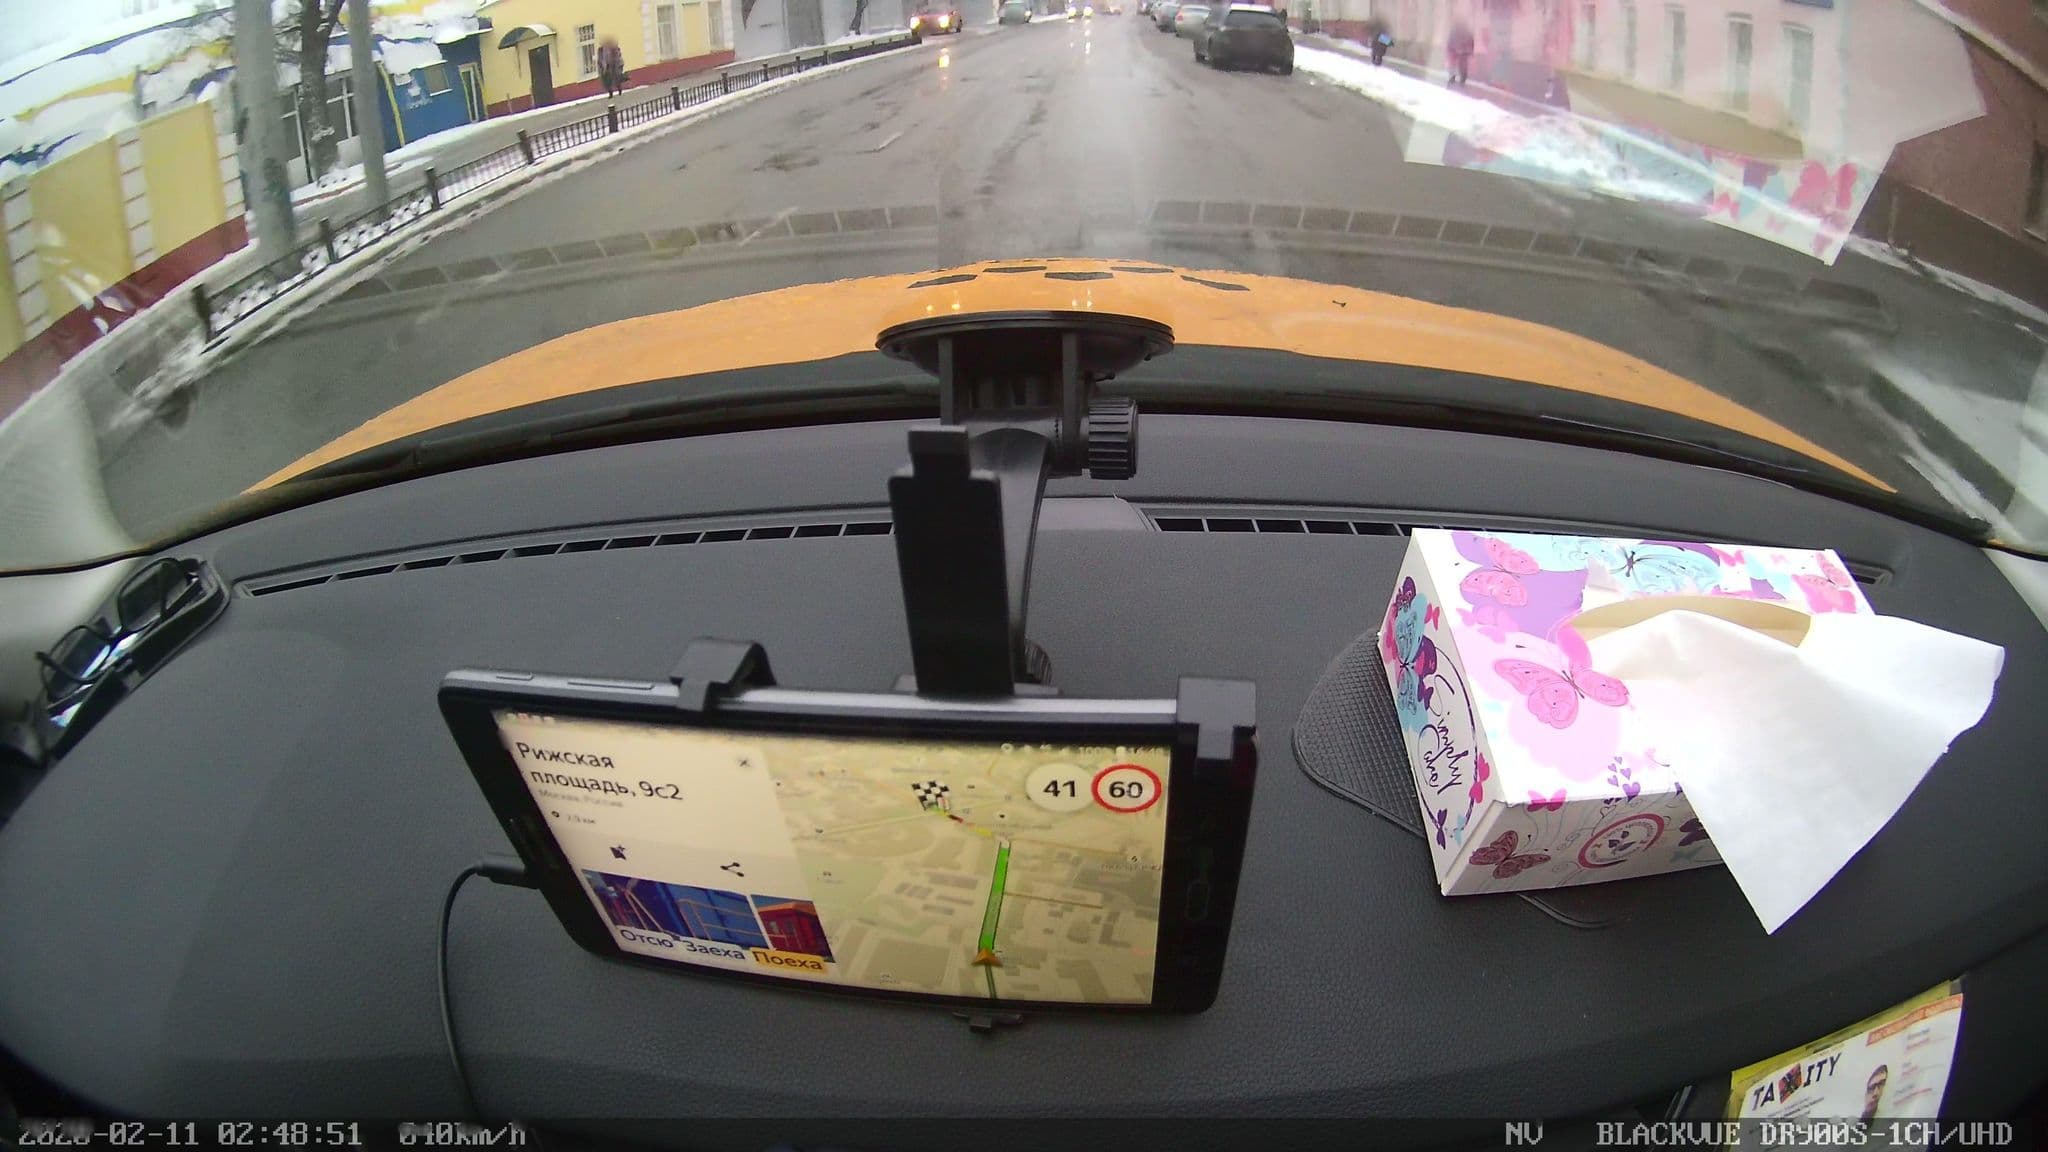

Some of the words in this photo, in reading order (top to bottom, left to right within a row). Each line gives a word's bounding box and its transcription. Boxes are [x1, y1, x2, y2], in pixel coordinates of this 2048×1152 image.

[516, 742, 615, 768] Рижская
[1418, 724, 1440, 788] Care
[531, 771, 636, 797] площадь,
[1043, 780, 1076, 797] 41
[1108, 781, 1143, 798] 60
[685, 940, 746, 960] Заеха
[752, 951, 824, 970] Поеха
